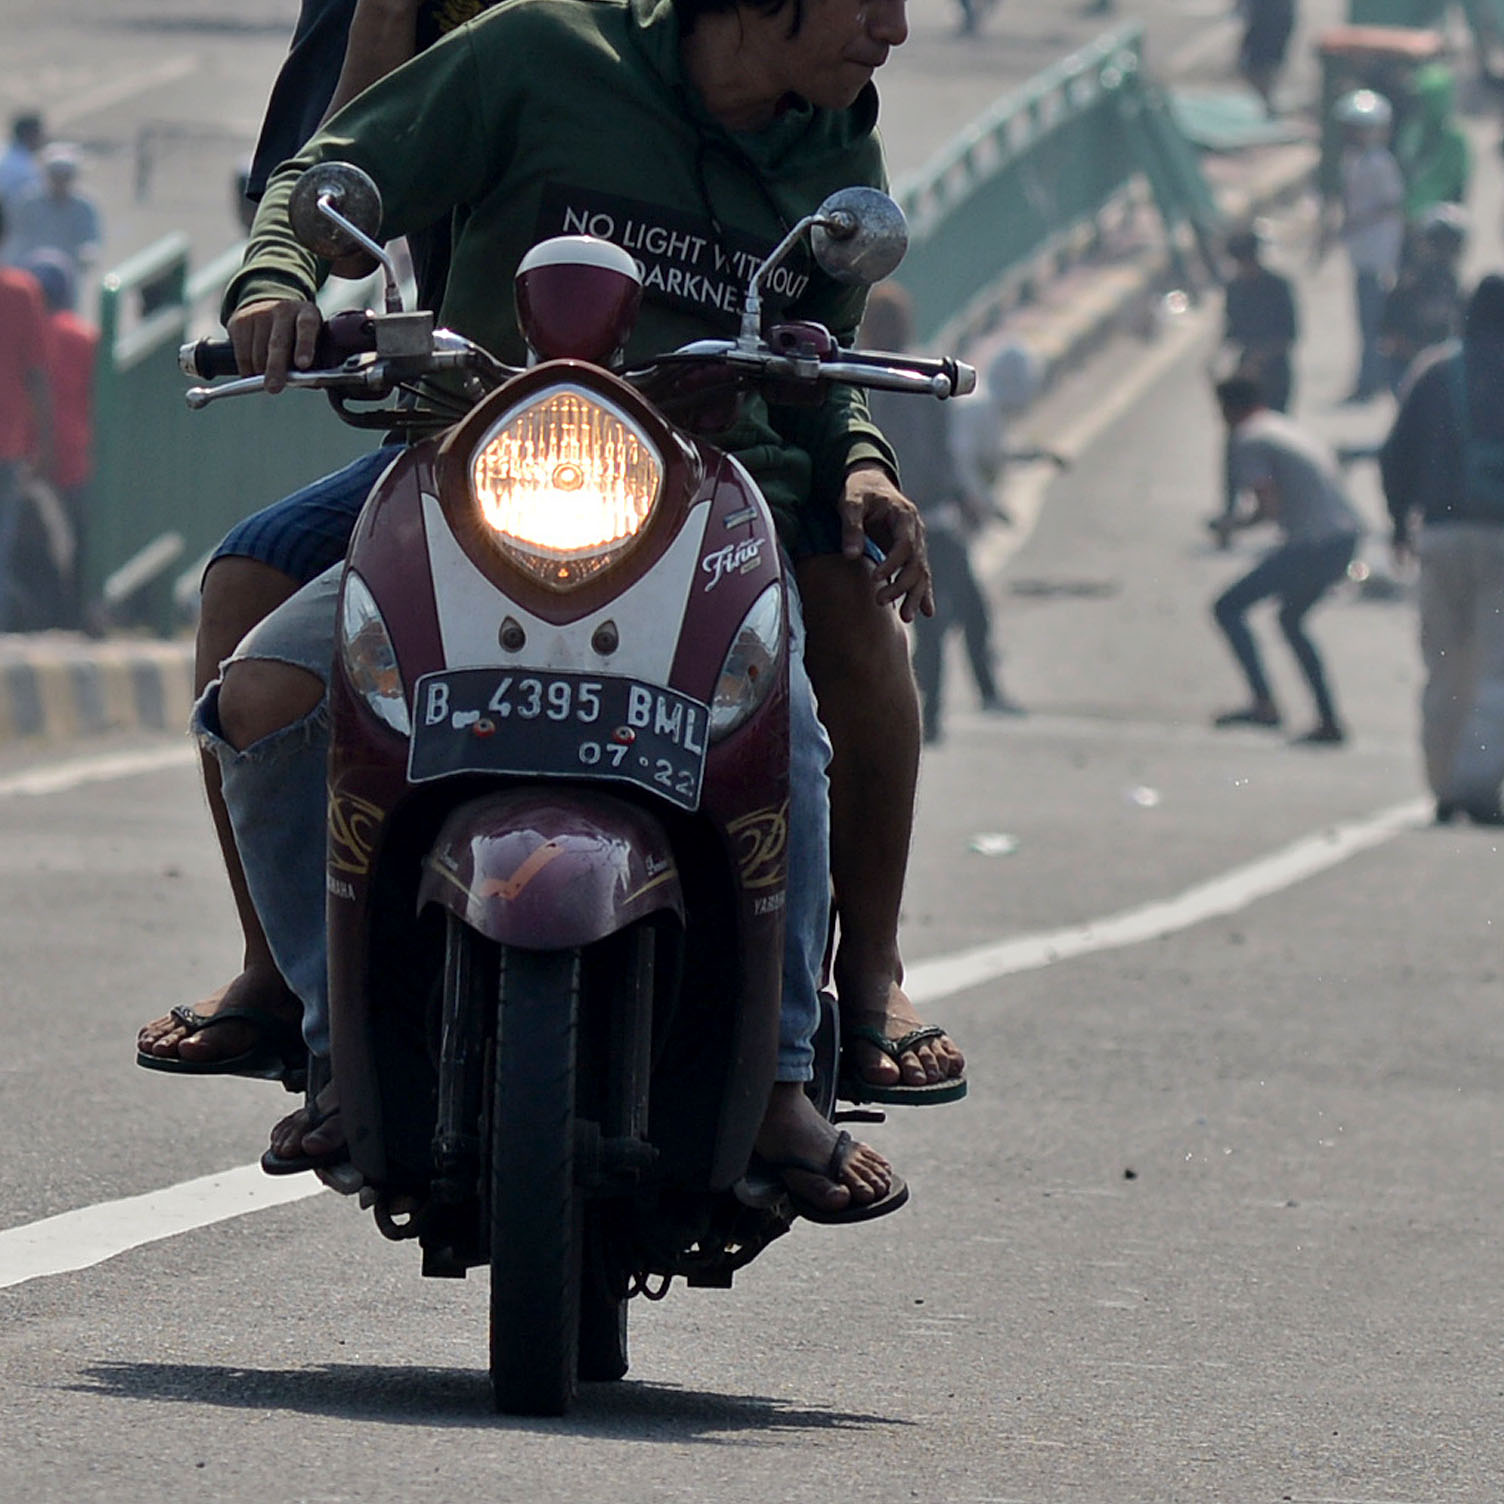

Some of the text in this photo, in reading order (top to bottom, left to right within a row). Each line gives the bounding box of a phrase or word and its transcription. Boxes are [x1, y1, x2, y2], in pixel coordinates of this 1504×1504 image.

[562, 206, 614, 240] NO
[622, 220, 706, 265] LIGHT
[635, 260, 763, 315] DARKNE
[702, 538, 766, 592] Fino
[425, 677, 702, 756] B 4395 BML
